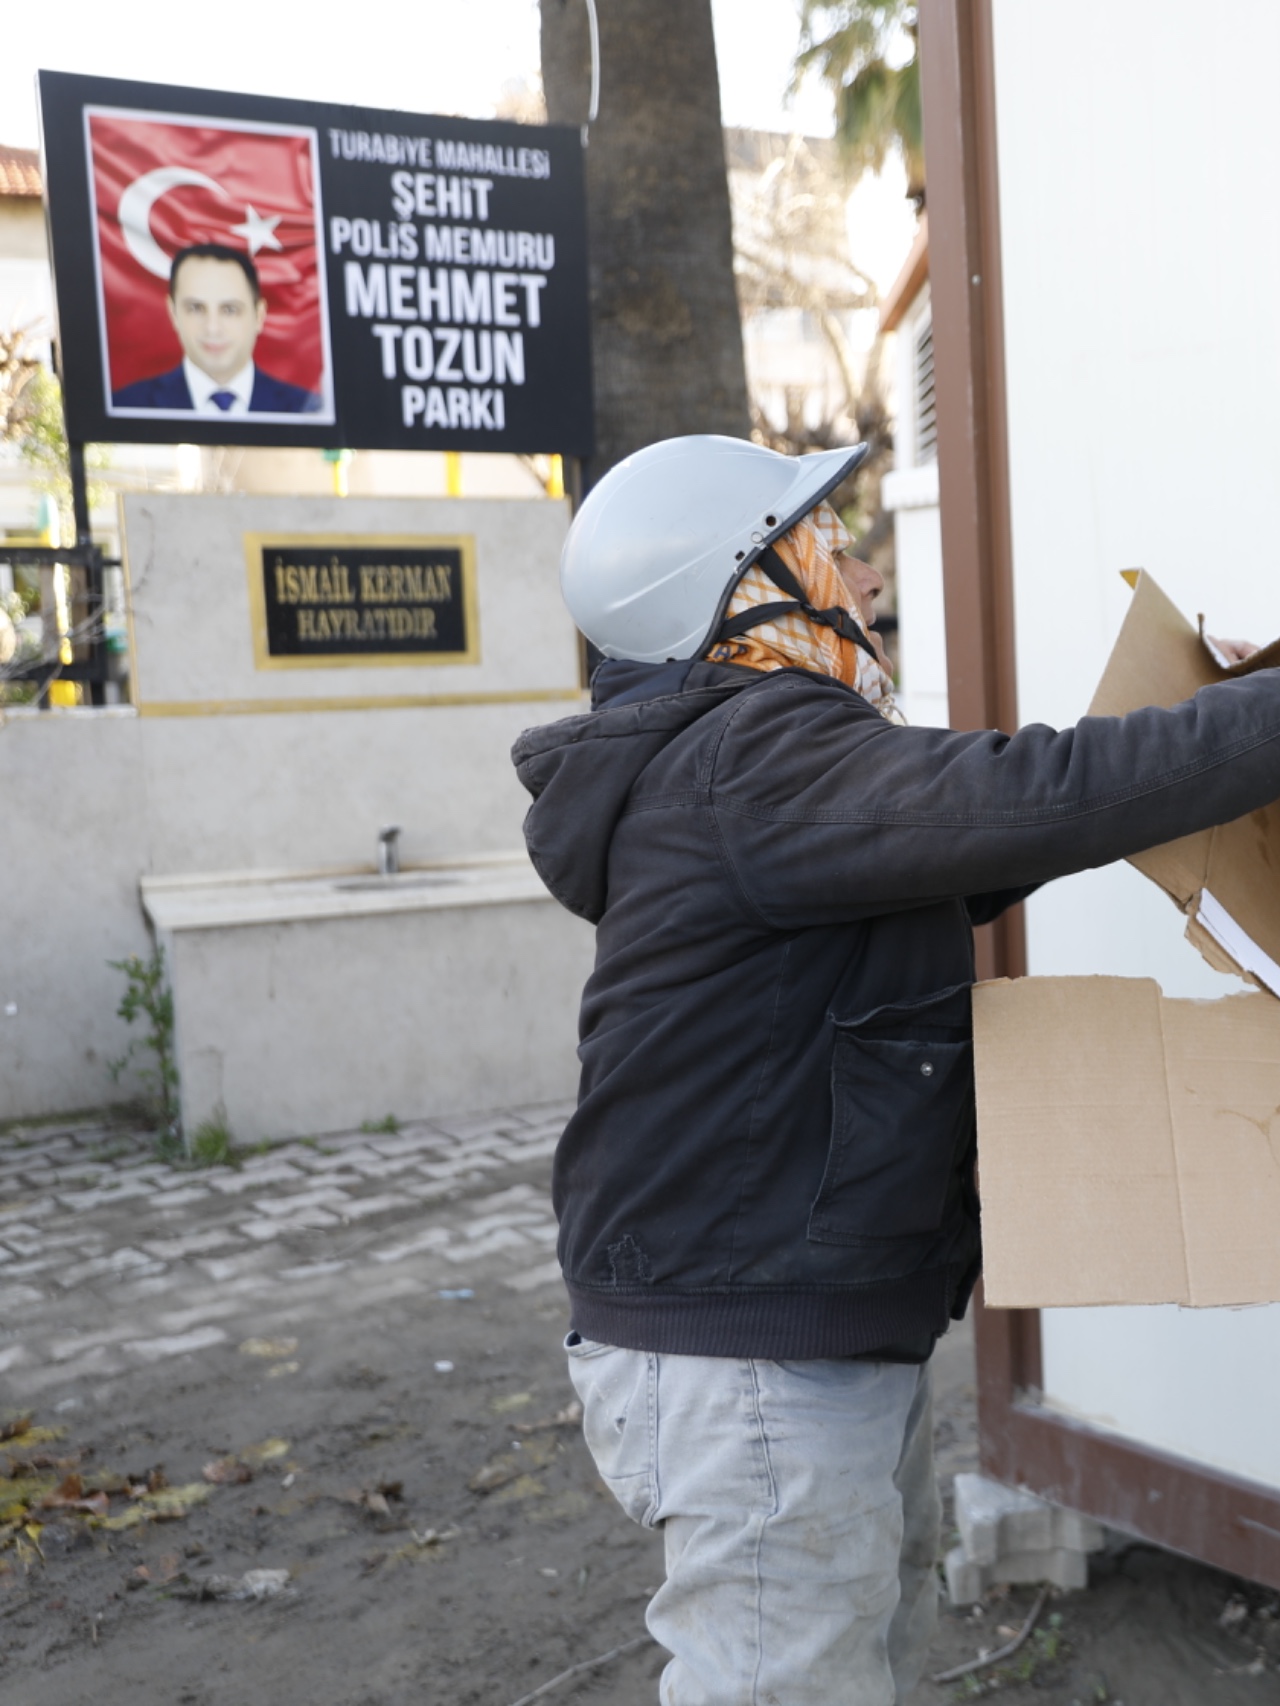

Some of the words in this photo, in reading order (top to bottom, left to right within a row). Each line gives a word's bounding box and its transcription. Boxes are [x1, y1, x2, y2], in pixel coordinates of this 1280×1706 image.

[328, 128, 433, 168] TURABİYE
[435, 139, 551, 179] MAHALLESİ
[391, 170, 493, 221] ŞEHİT
[424, 223, 555, 270] MEMURU
[344, 261, 548, 328] MEHMET
[371, 323, 526, 385] TOZUN
[402, 384, 506, 431] PARKI
[275, 556, 356, 604] İSMAİL
[297, 607, 439, 641] HAYRATIDIR
